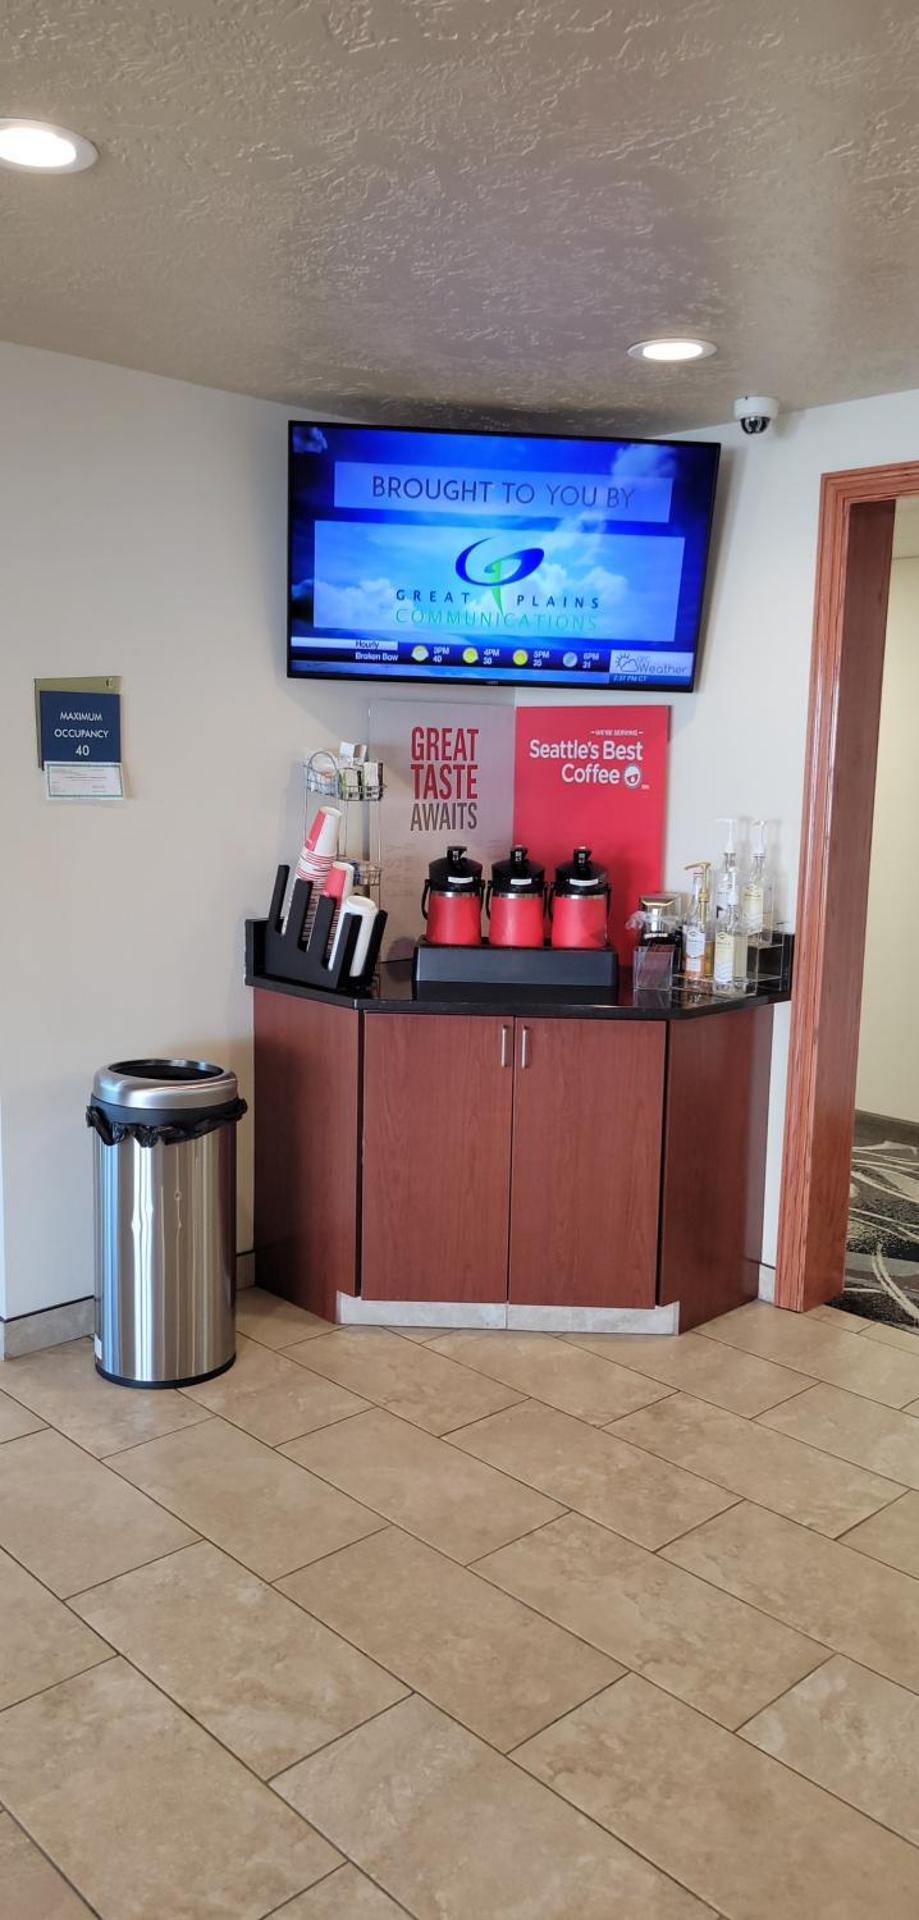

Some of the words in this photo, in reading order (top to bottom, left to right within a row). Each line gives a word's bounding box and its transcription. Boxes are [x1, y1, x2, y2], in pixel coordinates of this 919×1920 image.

[373, 475, 493, 503] BROUGHT
[502, 481, 535, 504] TO
[545, 484, 598, 508] YOU
[606, 487, 636, 509] BY
[396, 588, 471, 605] GREAT
[516, 594, 600, 609] PLAINS
[395, 607, 599, 631] COMMUNICATIONS
[355, 639, 380, 649] Hourly
[433, 646, 450, 655] 3PM
[483, 648, 500, 657] 4PM
[355, 651, 381, 661] Broken
[382, 652, 399, 662] Bow
[432, 655, 443, 663] 40
[639, 663, 689, 674] Weather
[60, 711, 103, 722] MAXIMUM
[54, 728, 110, 739] OCCUPANCY
[75, 744, 90, 757] 40
[411, 726, 479, 762] GREAT
[529, 739, 599, 760] Seattle's
[602, 740, 644, 761] Best
[410, 763, 478, 800] TASTE
[561, 763, 621, 784] Coffee
[410, 801, 478, 832] AWAITS
